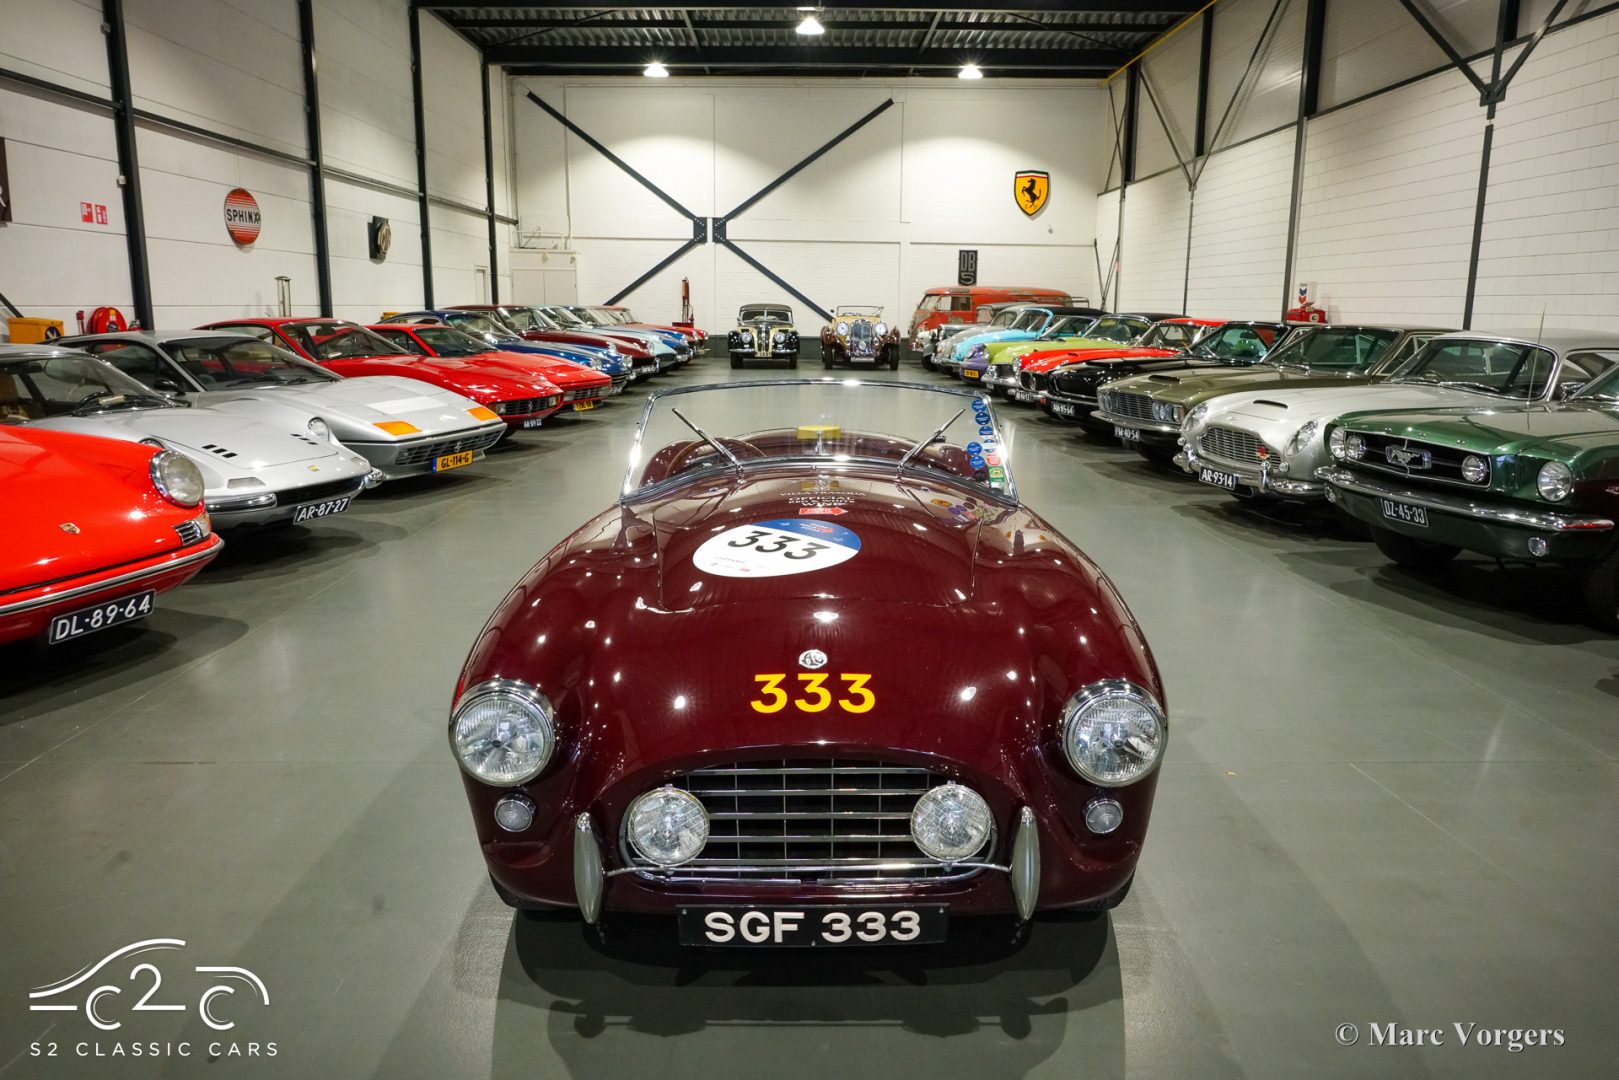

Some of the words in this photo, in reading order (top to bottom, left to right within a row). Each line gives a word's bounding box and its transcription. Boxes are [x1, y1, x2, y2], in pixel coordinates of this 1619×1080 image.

[226, 208, 260, 224] SPHINX
[960, 251, 976, 272] DB
[1201, 468, 1233, 488] AR-93-14
[296, 498, 349, 522] AR-87-27
[1384, 500, 1425, 524] DZ-45-33
[727, 530, 831, 560] 333
[55, 594, 151, 640] DL-89-64
[750, 673, 876, 714] 333
[704, 911, 805, 943] SGF
[821, 910, 921, 943] 333
